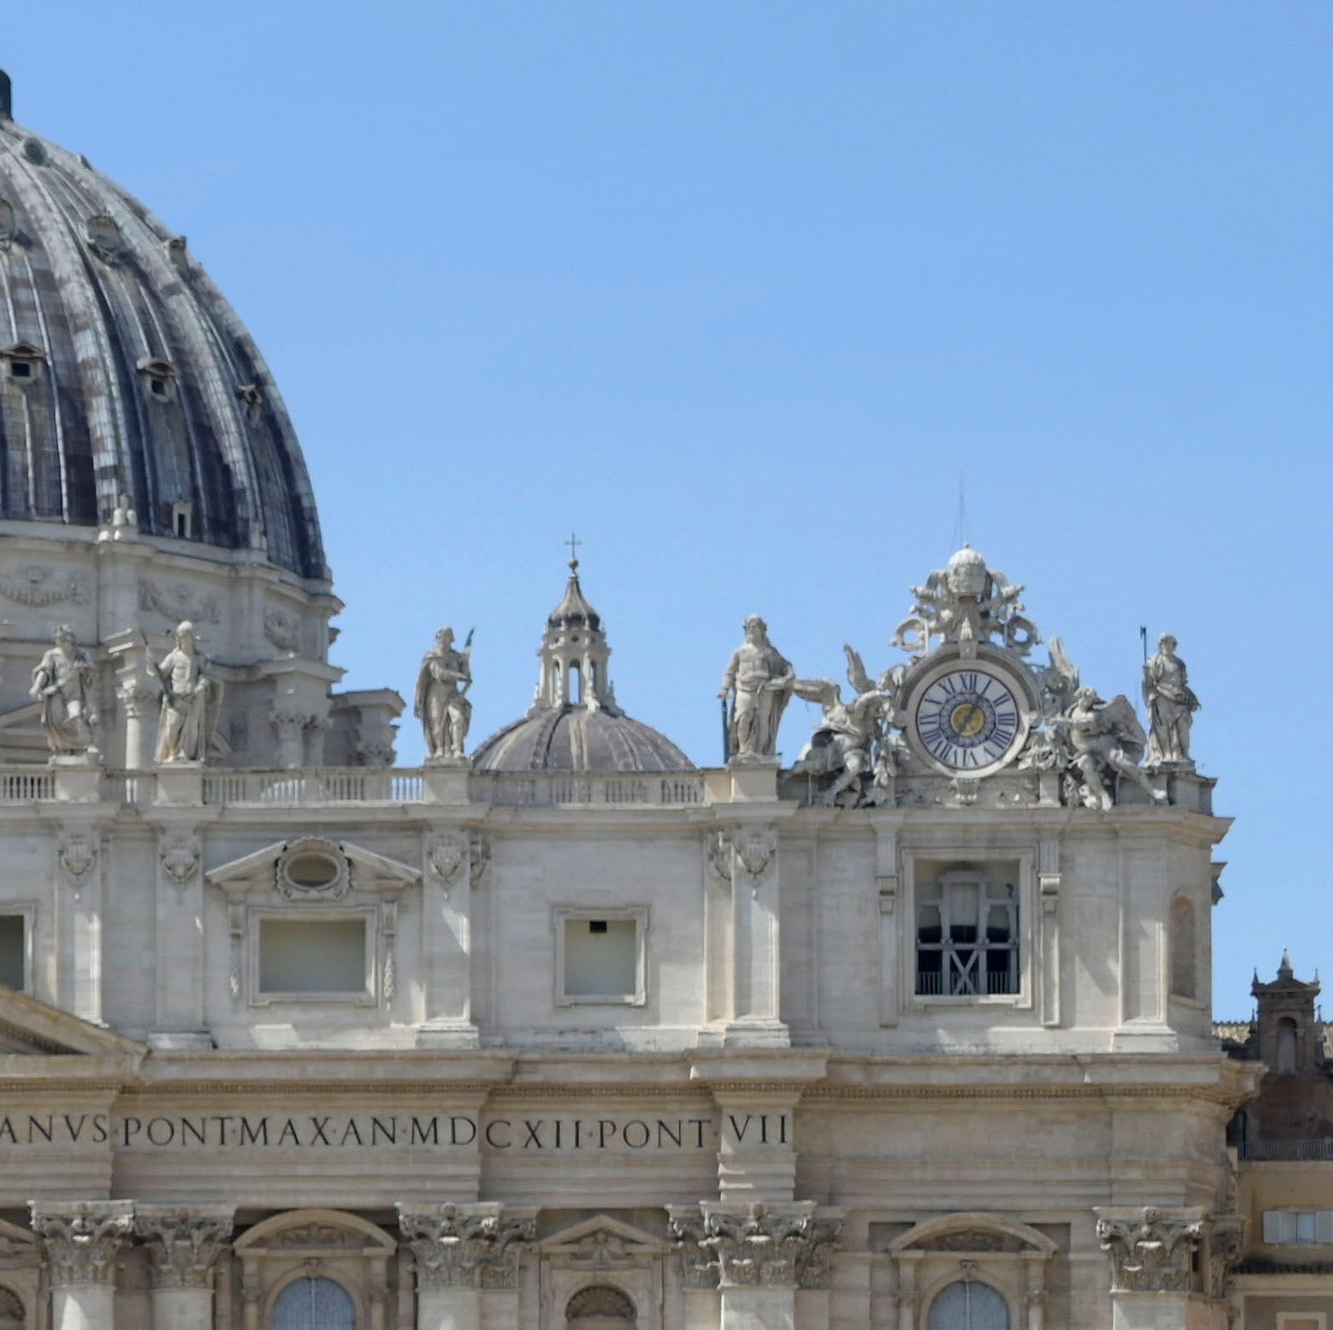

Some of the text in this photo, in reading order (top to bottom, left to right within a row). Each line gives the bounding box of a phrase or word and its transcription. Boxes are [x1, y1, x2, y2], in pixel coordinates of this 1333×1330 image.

[122, 1116, 233, 1147] PONT
[239, 1116, 333, 1147] MAX
[341, 1116, 398, 1147] AN
[410, 1116, 582, 1150] MDCXII
[598, 1118, 712, 1150] PONT
[728, 1113, 788, 1145] VII
